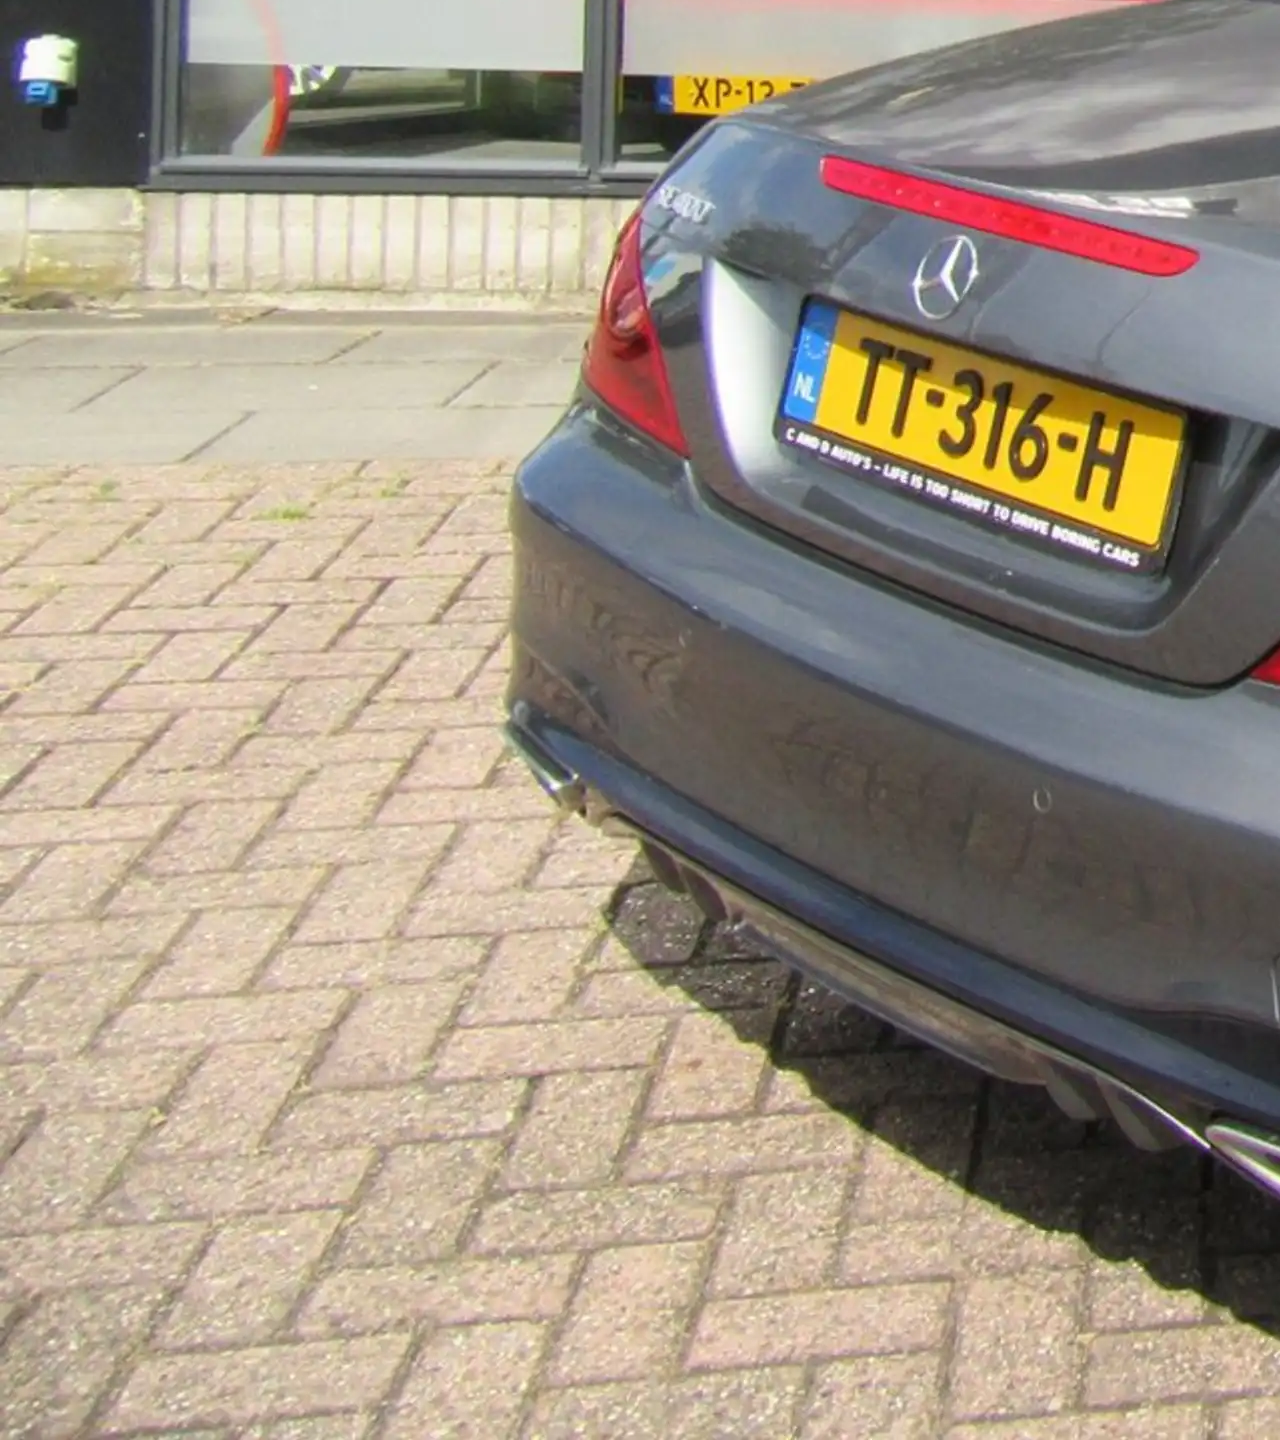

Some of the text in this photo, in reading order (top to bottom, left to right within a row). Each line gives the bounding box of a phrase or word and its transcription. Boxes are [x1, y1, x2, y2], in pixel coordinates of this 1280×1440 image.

[793, 372, 817, 403] NL
[854, 337, 1136, 511] TT-316-H
[910, 474, 923, 490] IS
